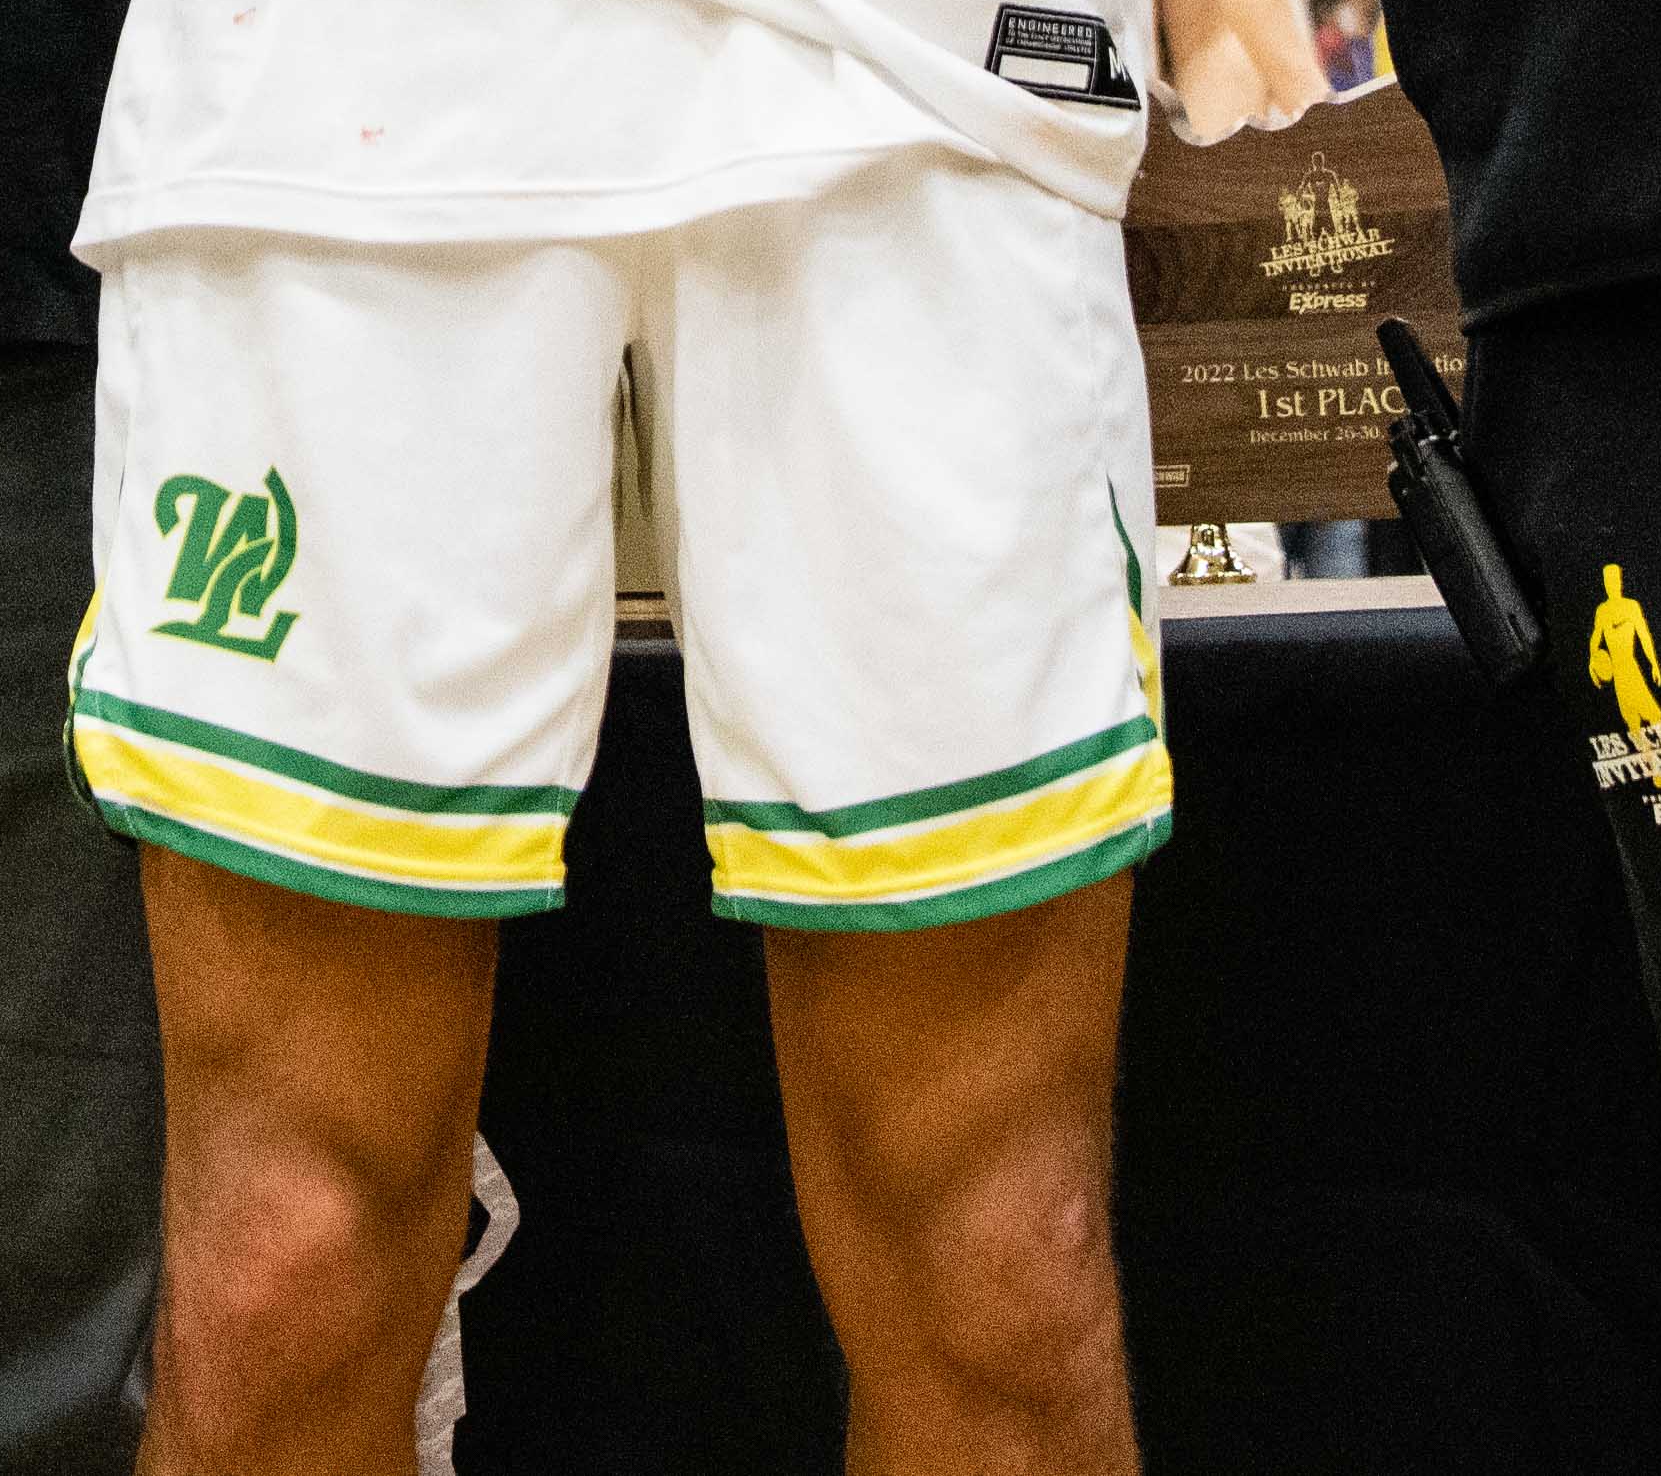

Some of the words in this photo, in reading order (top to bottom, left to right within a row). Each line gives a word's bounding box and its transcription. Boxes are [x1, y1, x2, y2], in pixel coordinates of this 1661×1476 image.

[1008, 16, 1093, 38] ENGINEERED
[1260, 239, 1394, 277] INVITATIONAL
[1270, 242, 1303, 260] LES
[1305, 227, 1381, 252] SCHWAB
[1181, 363, 1235, 383] 2022
[1243, 362, 1279, 381] Les
[1286, 358, 1369, 380] Schwab
[1258, 388, 1306, 419] 1st
[1318, 385, 1408, 417] PLAC
[1250, 428, 1329, 444] December
[1589, 732, 1629, 761] LES
